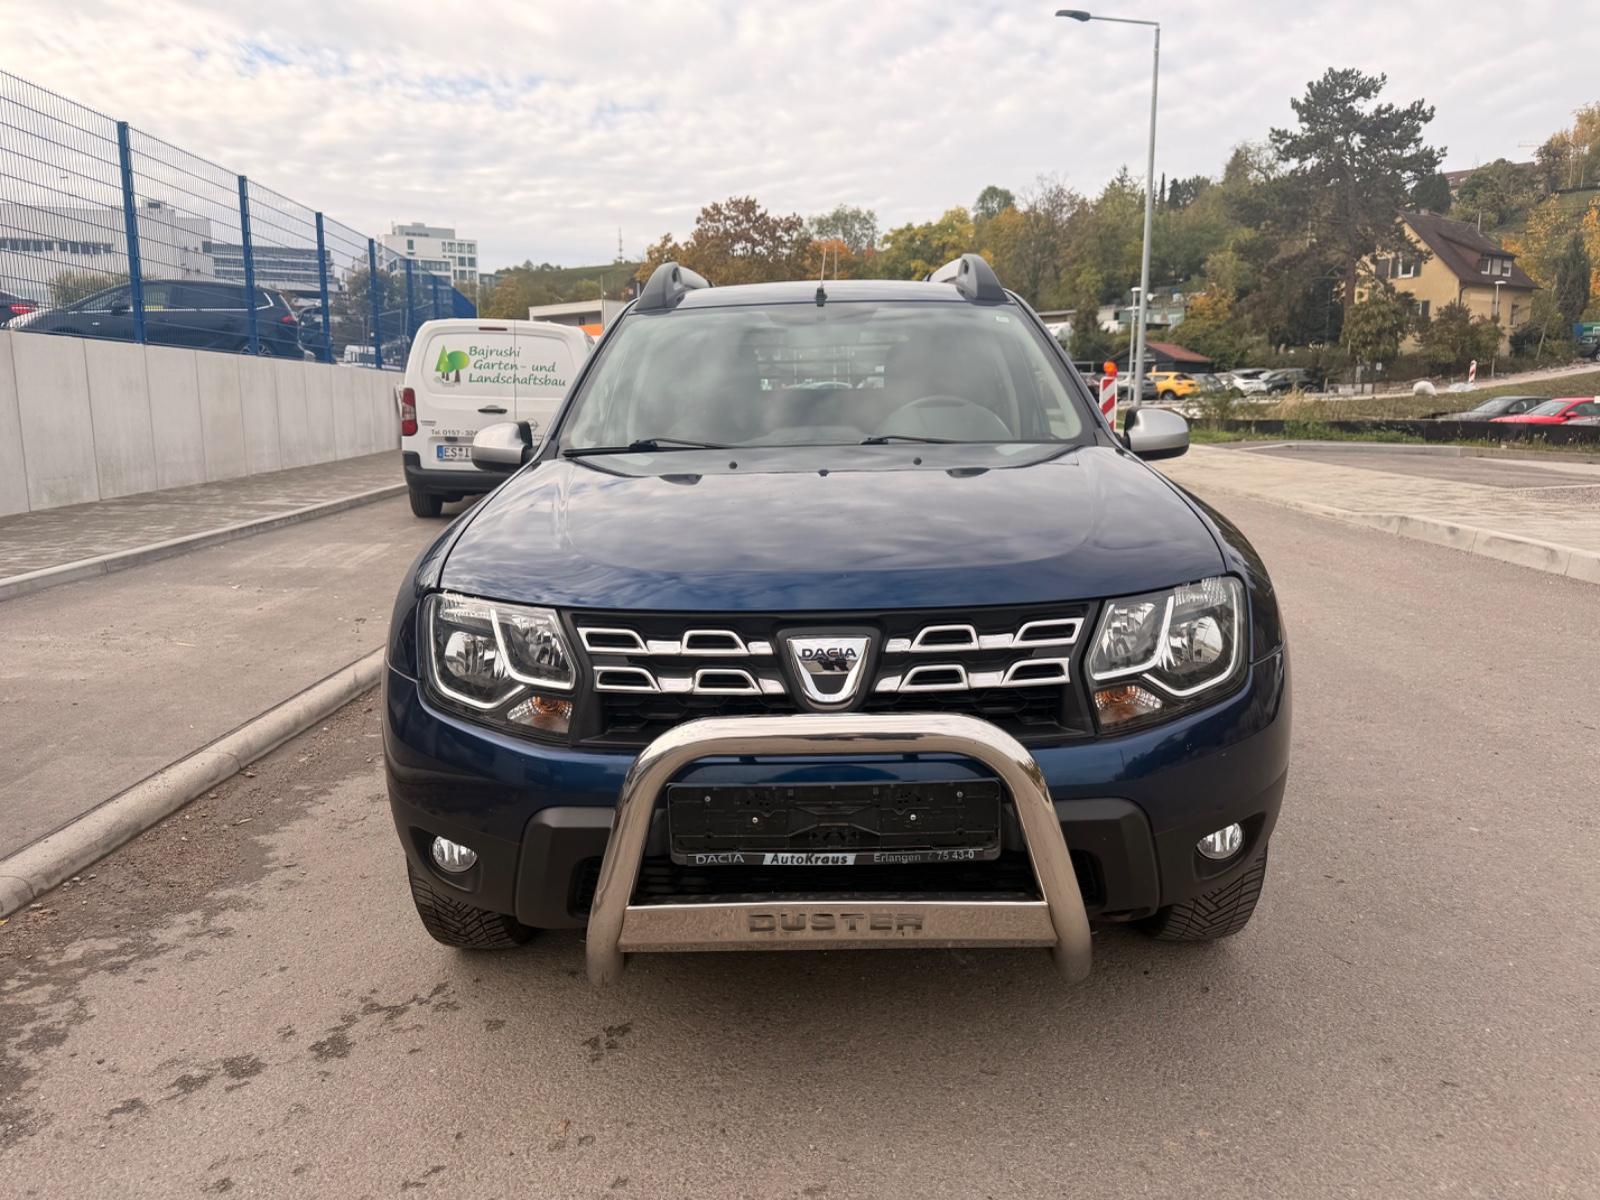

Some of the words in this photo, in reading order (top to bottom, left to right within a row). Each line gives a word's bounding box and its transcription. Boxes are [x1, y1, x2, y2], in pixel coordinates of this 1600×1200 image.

[468, 345, 521, 359] Bajrushi
[531, 361, 556, 373] und
[468, 373, 566, 386] Landschaftsbau
[444, 447, 457, 458] ES
[801, 648, 856, 658] DACIA
[695, 854, 745, 864] DACIA
[770, 853, 848, 865] AutoKraus
[873, 852, 921, 864] Erlangen
[749, 913, 923, 932] DUSTER
